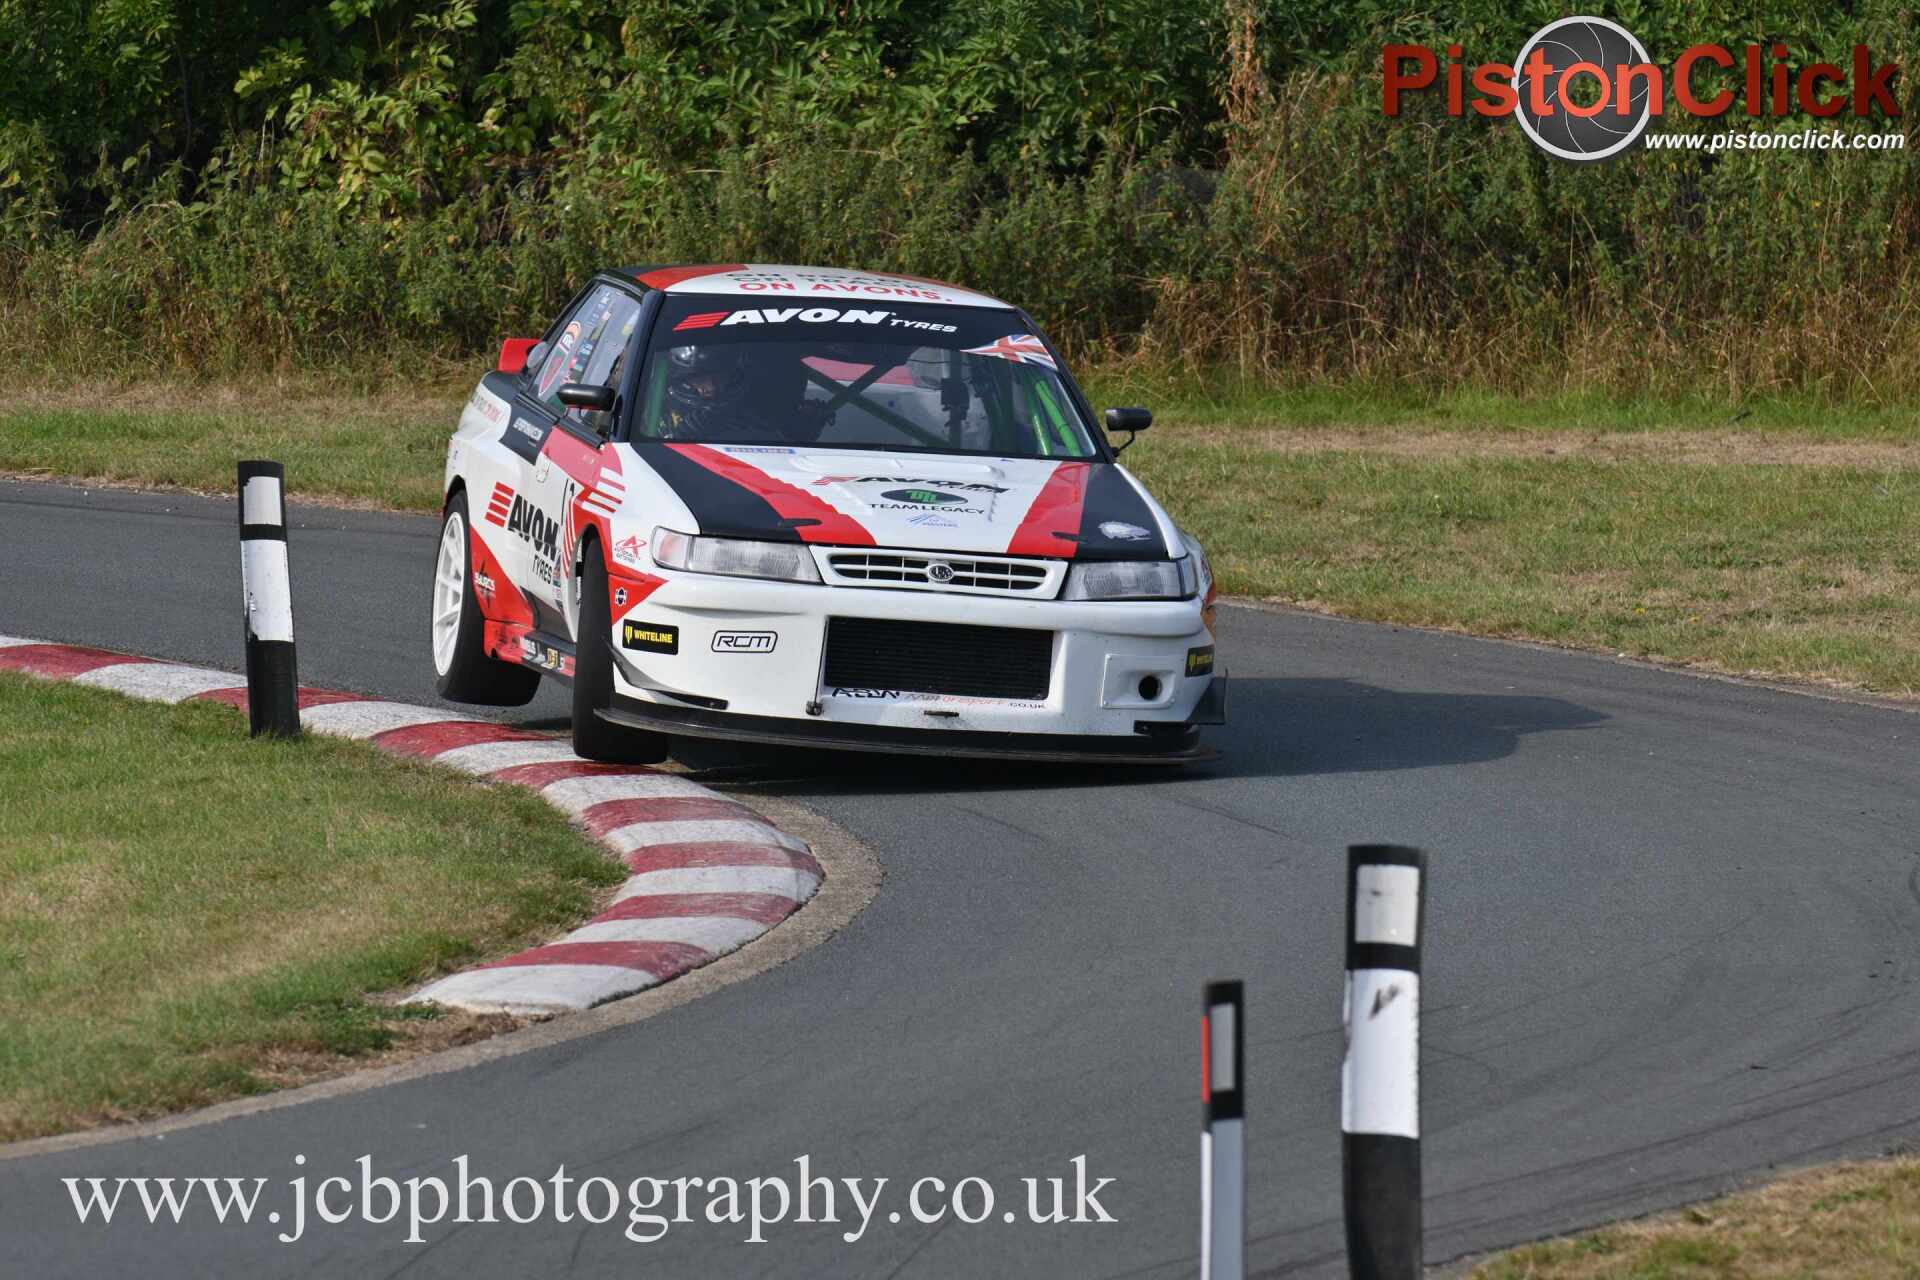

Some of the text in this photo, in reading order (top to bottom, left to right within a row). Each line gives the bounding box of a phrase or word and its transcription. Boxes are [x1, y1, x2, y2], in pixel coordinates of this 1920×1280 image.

[739, 282, 953, 303] ON AVONS.
[720, 308, 958, 333] AVON TYRES
[507, 493, 560, 562] AVON
[532, 553, 553, 585] TYRES
[633, 629, 673, 644] WHITELINE
[717, 635, 771, 648] RCM
